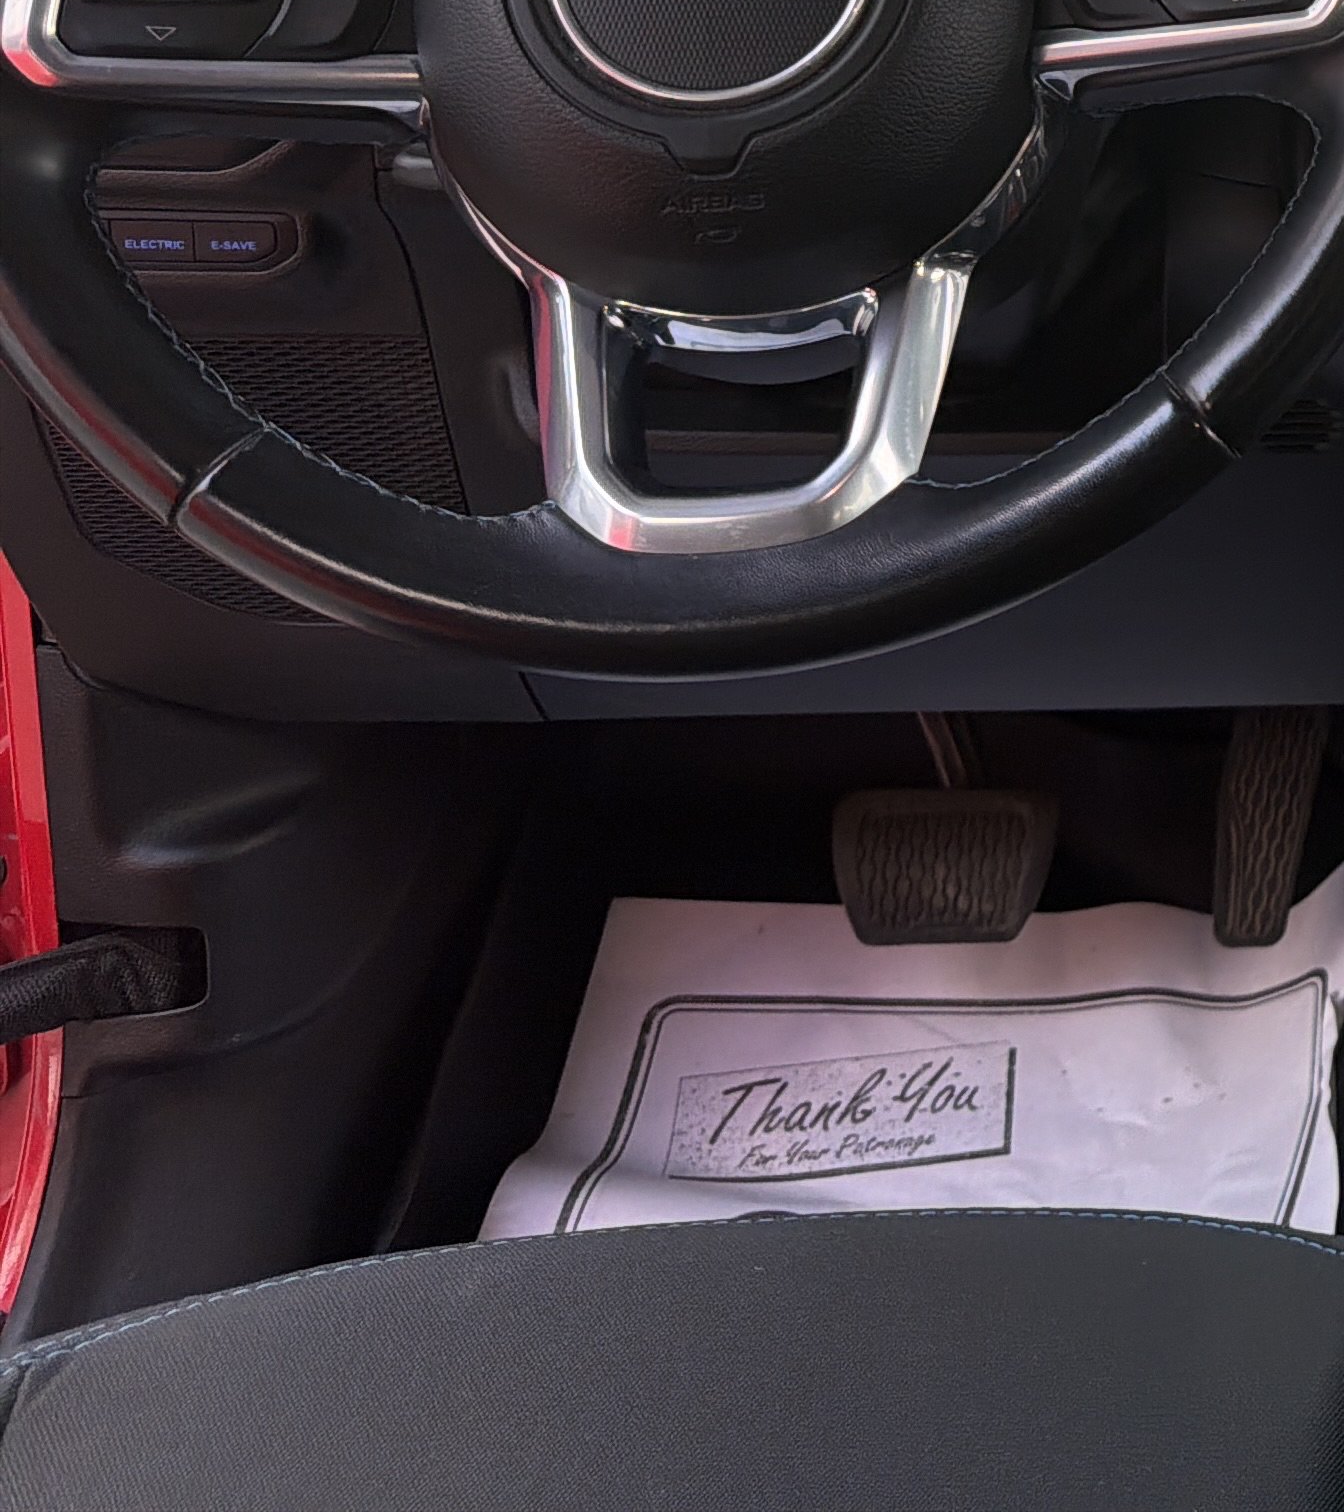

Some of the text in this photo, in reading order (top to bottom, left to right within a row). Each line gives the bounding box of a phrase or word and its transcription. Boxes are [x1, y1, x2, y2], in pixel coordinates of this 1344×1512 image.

[124, 239, 185, 251] ELECTRIC
[210, 239, 256, 251] E-SAVE
[709, 1056, 979, 1145] Thank You
[738, 1144, 778, 1169] For
[786, 1139, 829, 1163] Your
